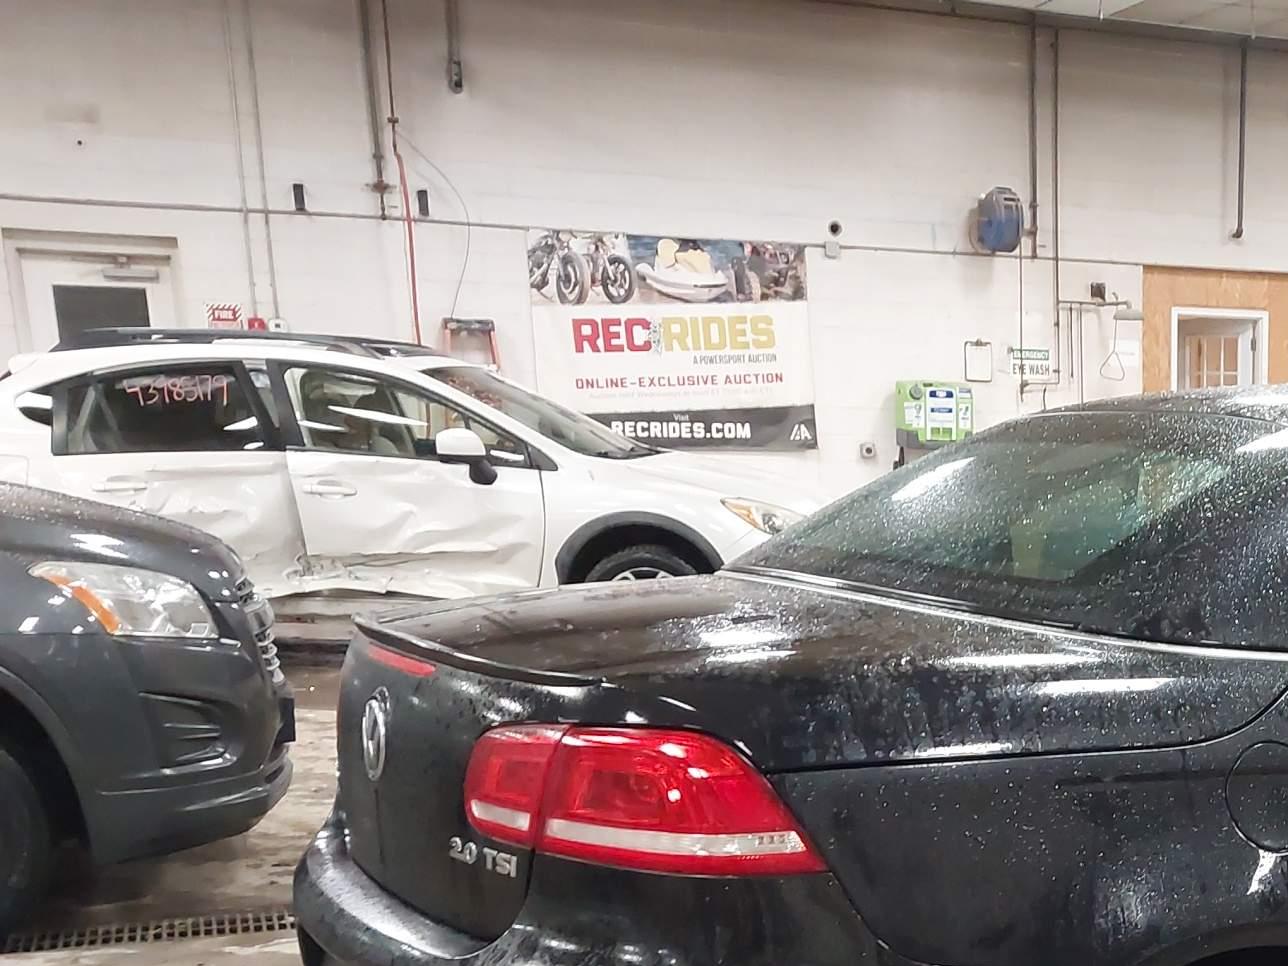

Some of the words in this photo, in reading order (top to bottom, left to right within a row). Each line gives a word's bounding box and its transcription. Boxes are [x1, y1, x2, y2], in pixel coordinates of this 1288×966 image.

[214, 310, 235, 319] FIRE
[699, 354, 745, 364] POWERSPORT
[748, 353, 777, 363] AUCTION
[1013, 363, 1026, 375] EYE
[1029, 363, 1050, 376] WASH
[576, 374, 718, 390] ONLINE-EXCLUSIVE
[724, 372, 783, 385] AUCTION
[673, 413, 689, 421] Visit
[611, 421, 751, 439] RECRIDES.COM
[482, 847, 518, 878] TSI
